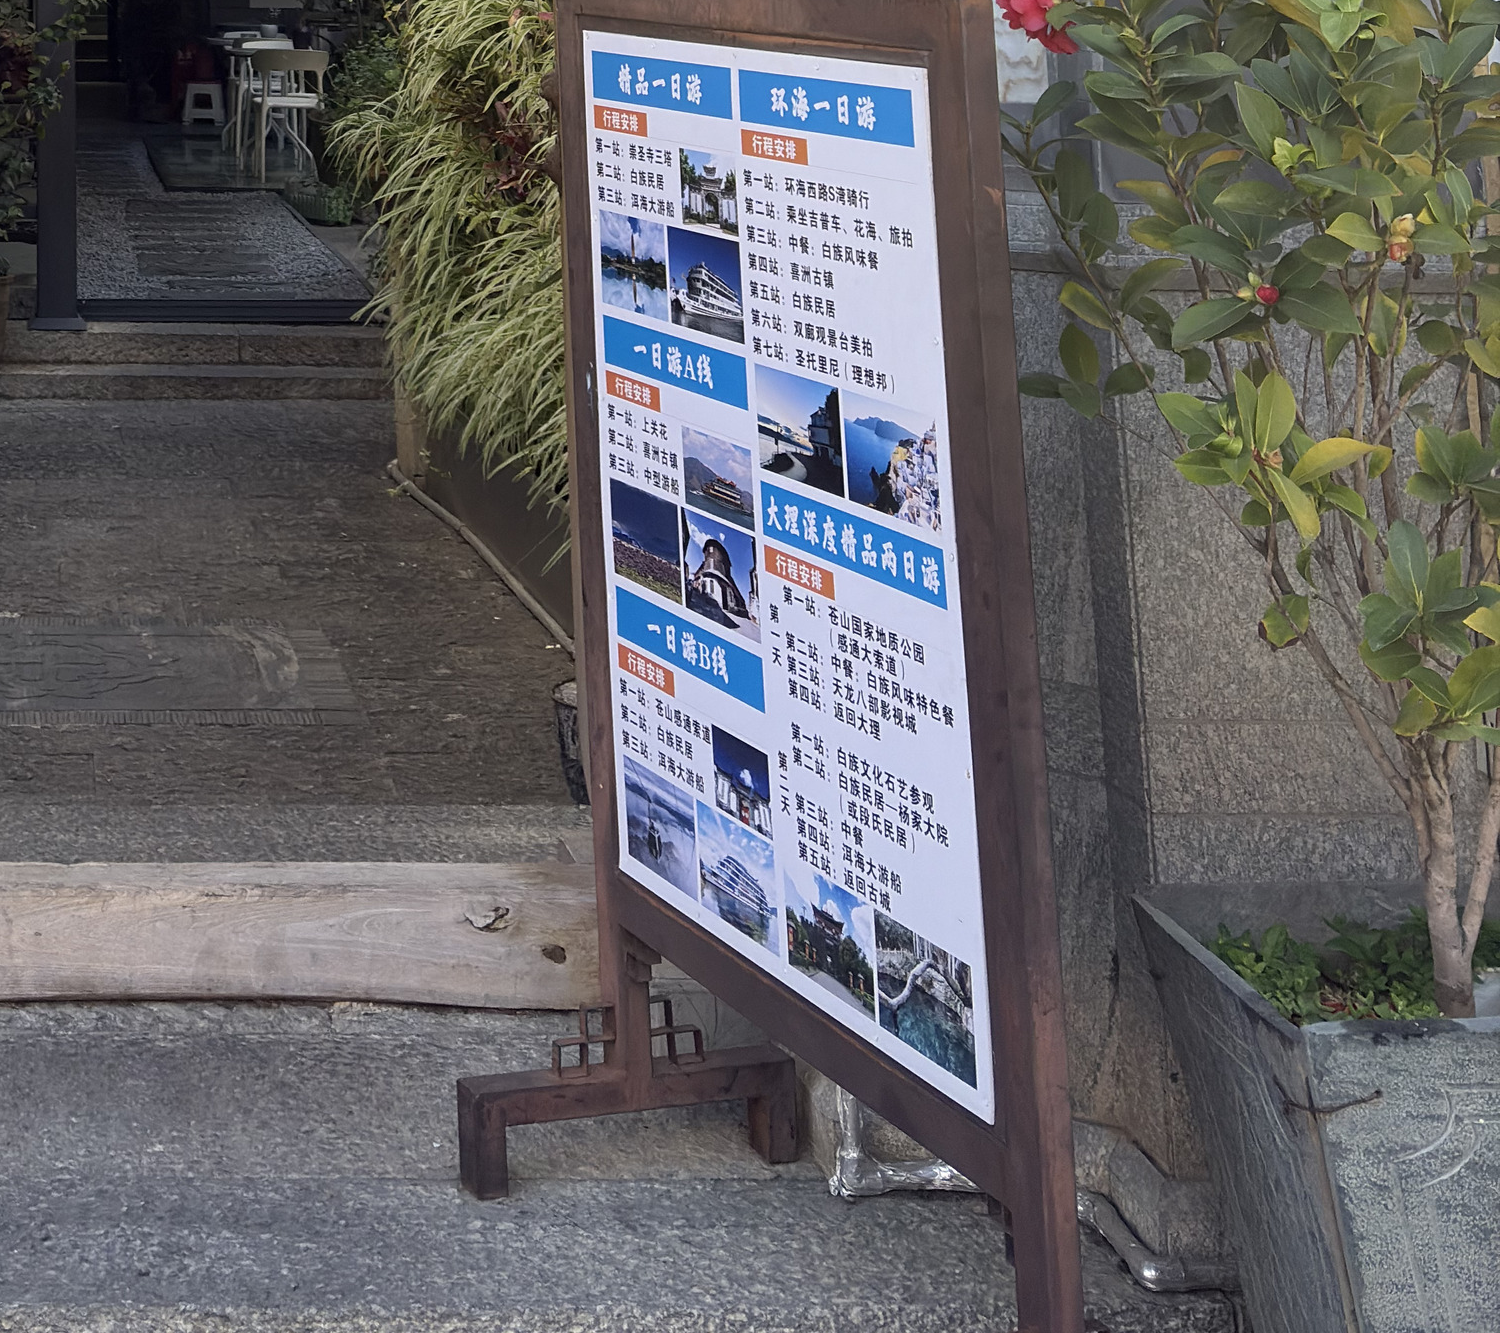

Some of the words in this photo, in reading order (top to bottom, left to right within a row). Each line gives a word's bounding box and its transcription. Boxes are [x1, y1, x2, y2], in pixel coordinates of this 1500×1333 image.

[618, 63, 702, 105] 精品一日游
[602, 109, 639, 132] 行程安排
[770, 86, 877, 131] 环海一日游
[752, 134, 796, 160] 行程安排
[633, 342, 714, 390] 一日游A线
[615, 377, 651, 405] 行程安排
[766, 495, 941, 595] 大理深度精品两日游
[775, 553, 823, 591] 行程安排
[627, 652, 666, 688] 行程安排
[646, 624, 729, 685] 一日游B线
